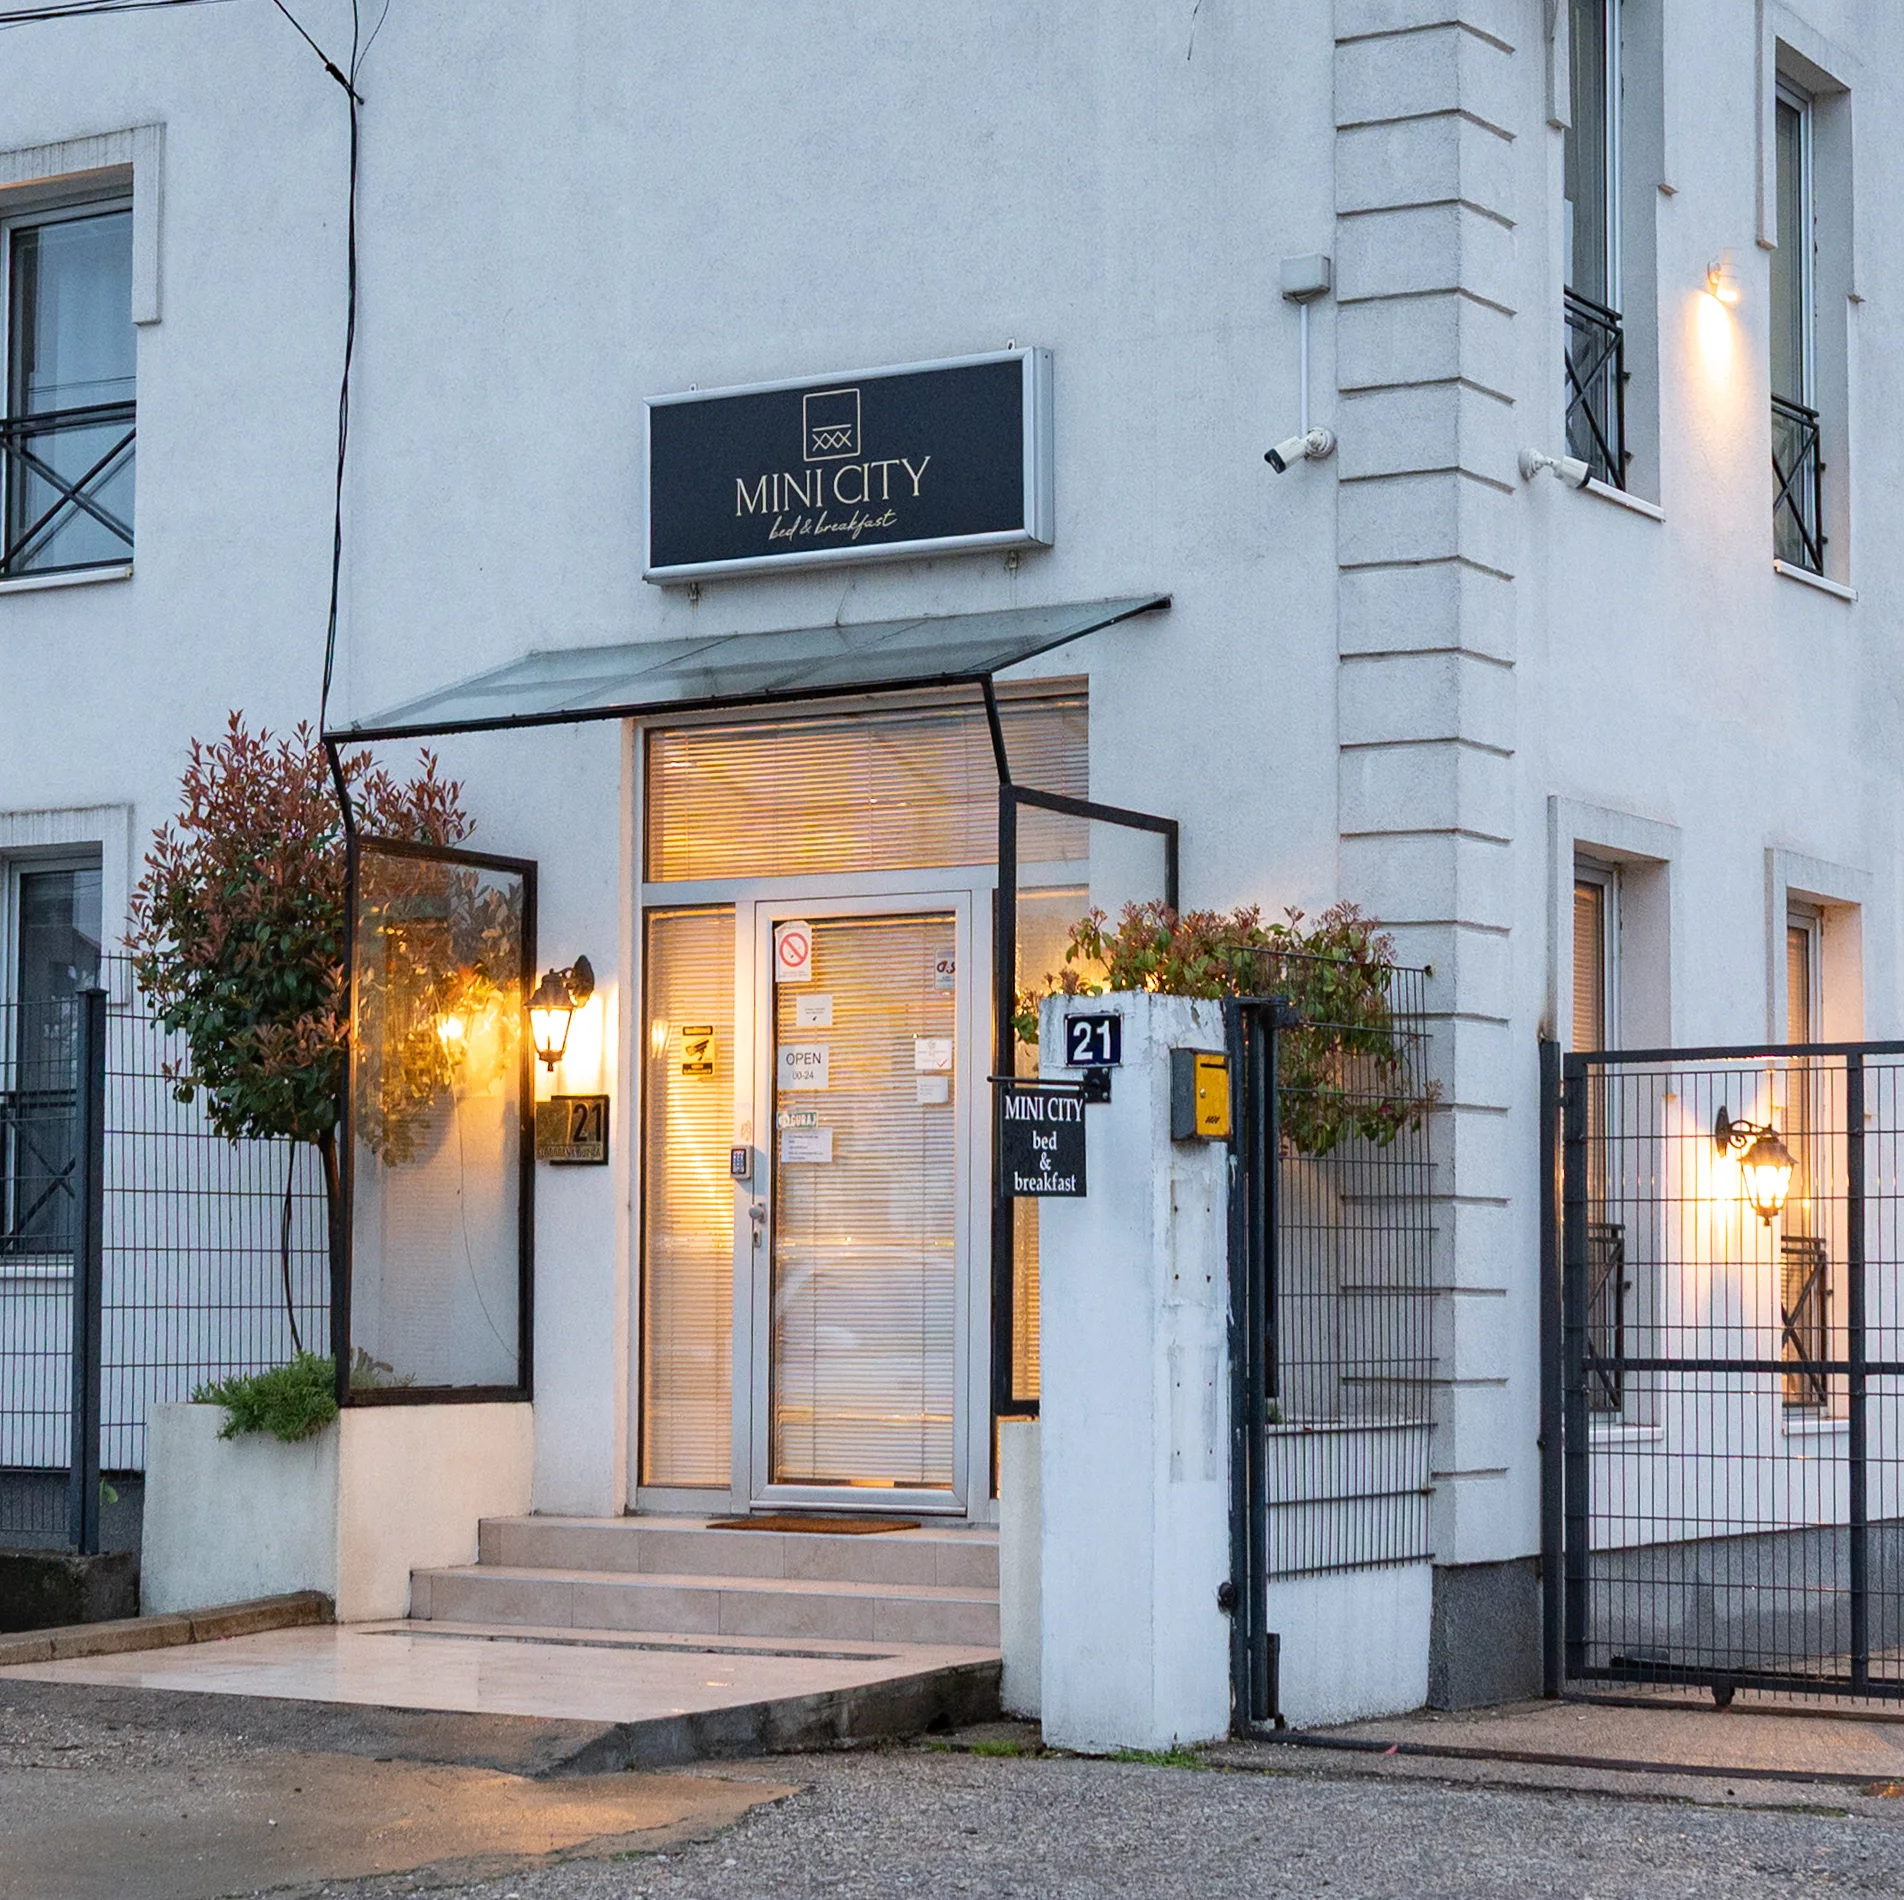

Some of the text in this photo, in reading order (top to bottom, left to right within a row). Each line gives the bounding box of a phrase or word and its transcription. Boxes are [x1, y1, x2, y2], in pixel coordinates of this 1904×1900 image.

[735, 456, 931, 517] MINI CITY
[769, 508, 897, 541] bed & breakfast
[1072, 1020, 1112, 1061] 21
[786, 1052, 822, 1066] OPEN
[792, 1070, 815, 1081] 00-24
[1005, 1095, 1084, 1122] MINI CITY
[573, 1103, 602, 1142] 21
[1032, 1130, 1058, 1151] bed
[1039, 1152, 1052, 1171] &
[1014, 1171, 1077, 1192] breakfast
